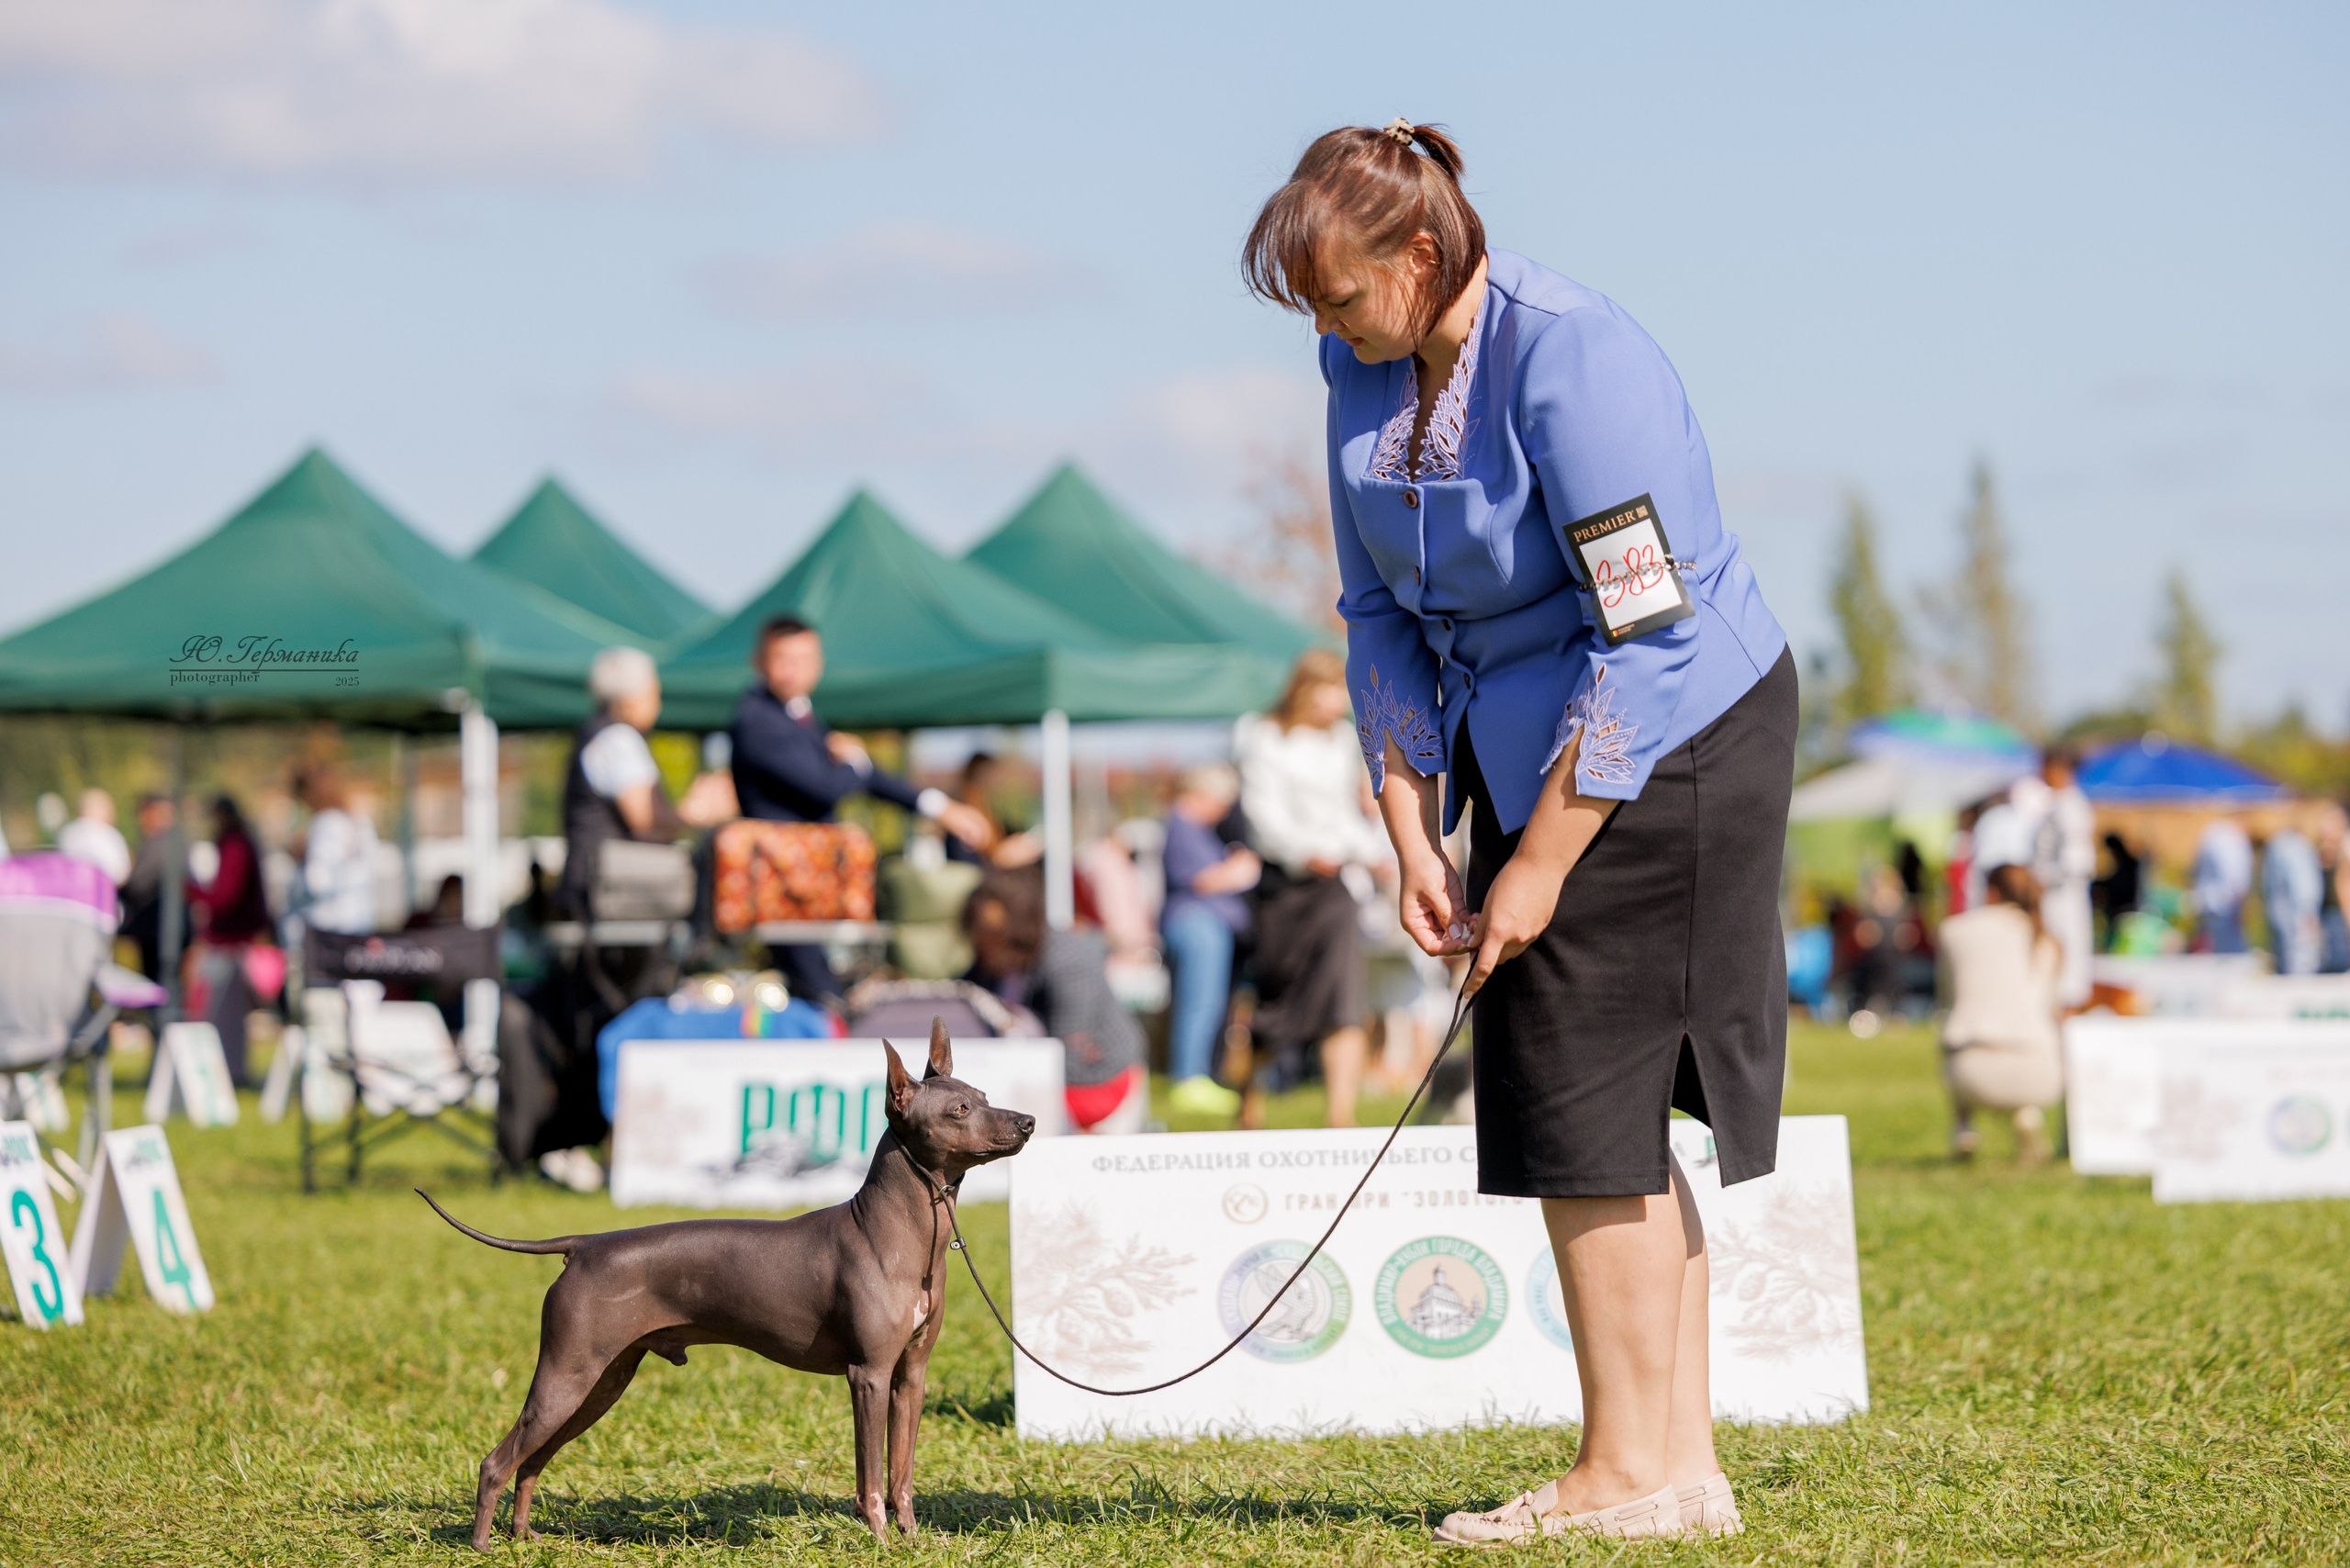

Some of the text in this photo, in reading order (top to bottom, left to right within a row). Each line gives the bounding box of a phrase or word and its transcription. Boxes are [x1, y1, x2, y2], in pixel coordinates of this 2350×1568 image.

[1573, 510, 1637, 543] PREMIER
[1091, 1151, 1251, 1172] ФЕДЕРАЦИЯ
[1285, 1193, 1337, 1211] ГРАН
[11, 1190, 63, 1322] 3
[151, 1189, 199, 1310] 4
